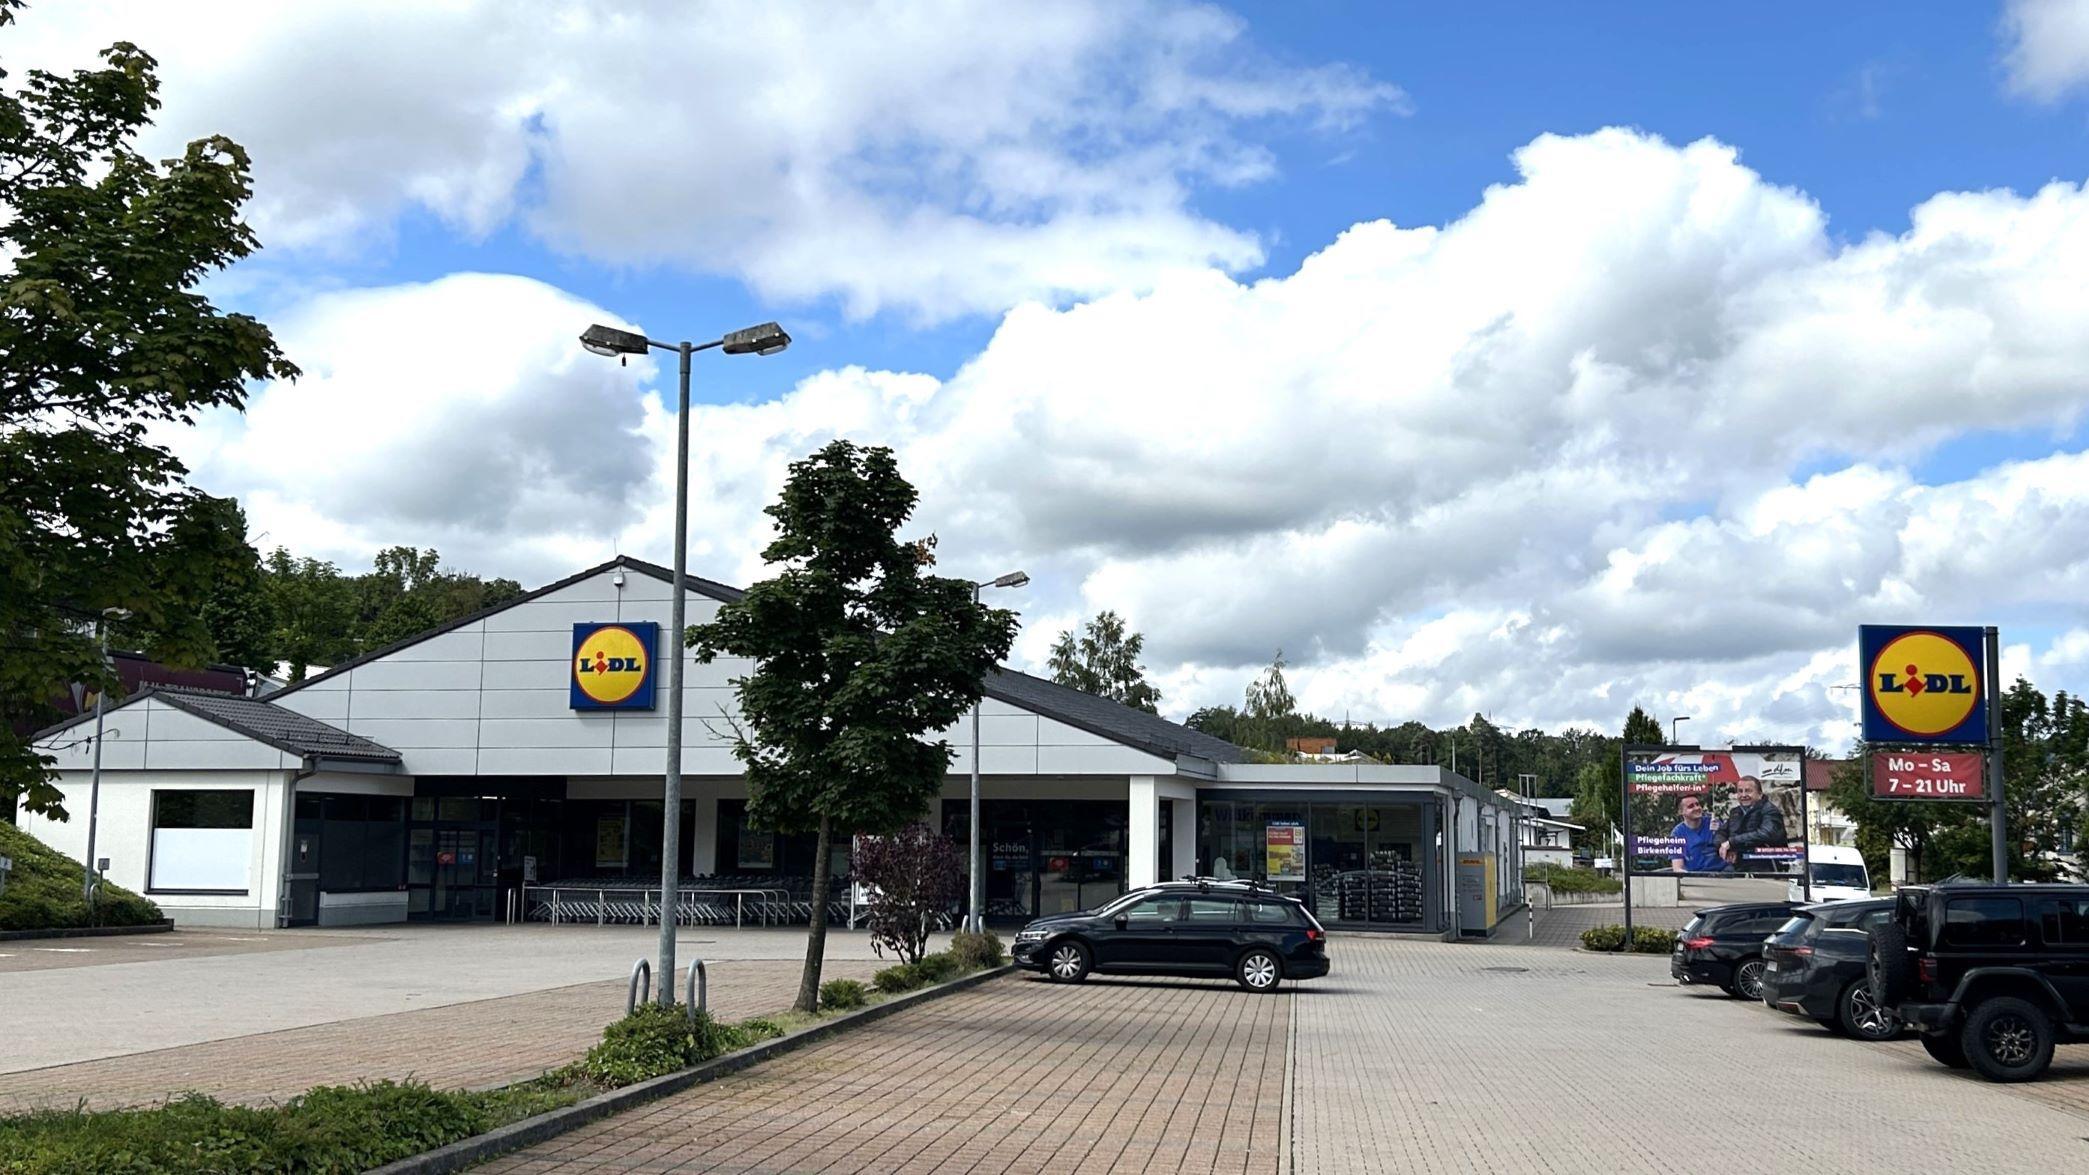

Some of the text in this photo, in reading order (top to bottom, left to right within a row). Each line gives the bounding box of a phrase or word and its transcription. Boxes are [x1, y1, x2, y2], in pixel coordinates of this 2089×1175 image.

[1674, 764, 1691, 772] fürs
[1888, 758, 1915, 772] Mo
[1931, 758, 1952, 773] Sa
[1888, 779, 1899, 793] 7
[1915, 779, 1932, 793] 21
[1936, 779, 1966, 793] Uhr
[1637, 836, 1687, 845] Pflegeheim
